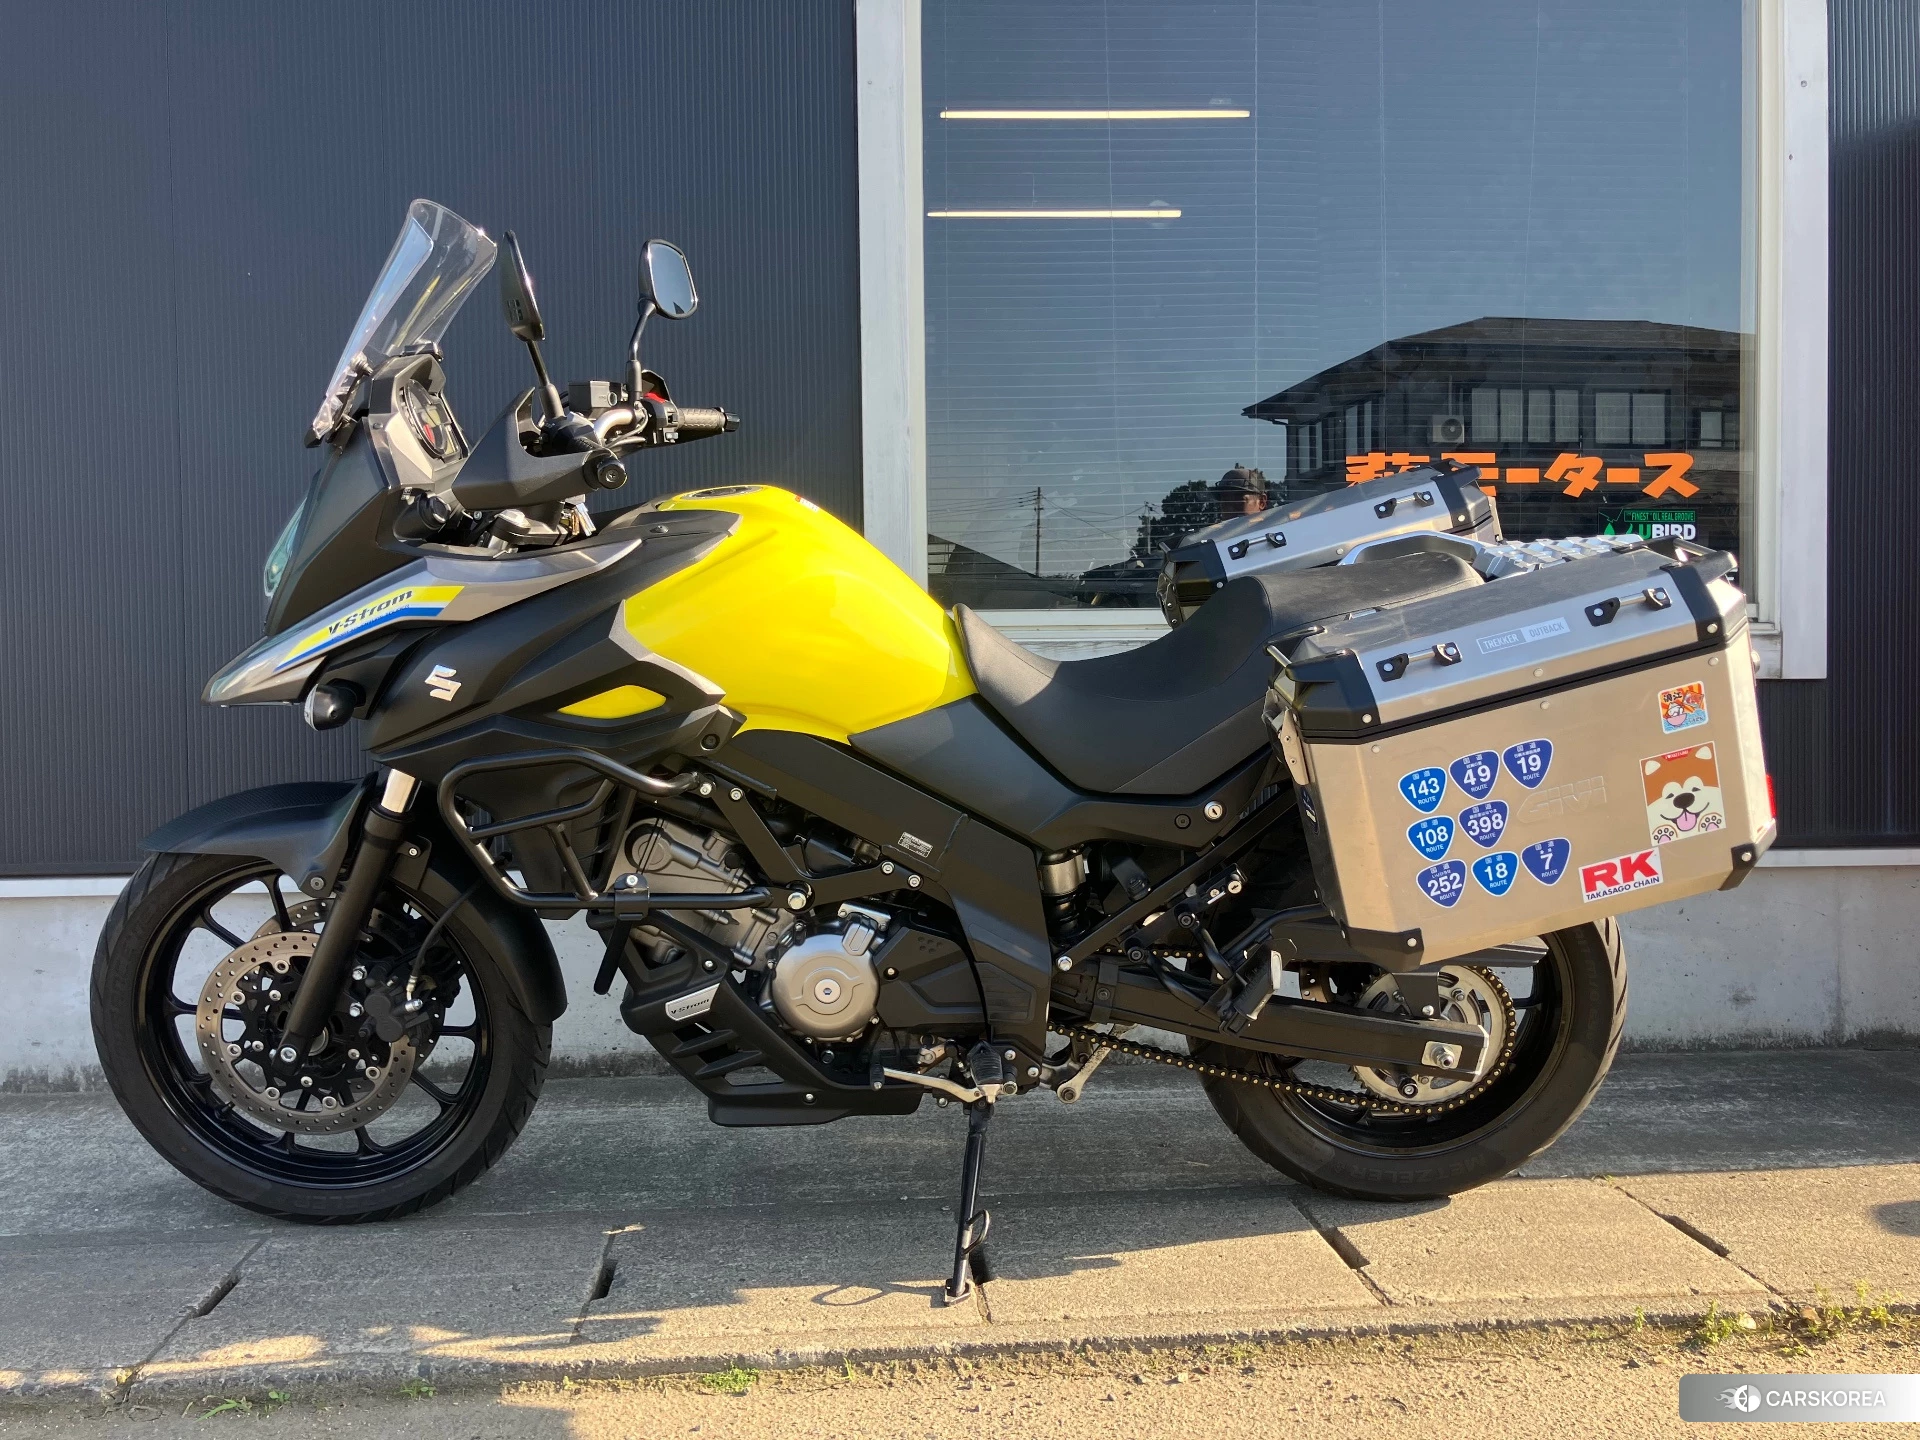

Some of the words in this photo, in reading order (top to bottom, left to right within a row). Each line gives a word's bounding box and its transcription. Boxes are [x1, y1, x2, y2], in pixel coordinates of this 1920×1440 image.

[1483, 633, 1520, 650] TREKKER
[1529, 621, 1565, 638] OUTBACK
[1517, 754, 1541, 774] 19
[1463, 765, 1491, 786] 49
[1523, 772, 1540, 780] ROUTE
[1408, 778, 1440, 799] 143
[1471, 783, 1488, 792] ROUTE
[1418, 796, 1436, 805] ROUTE
[1467, 813, 1503, 836] 398
[1416, 826, 1448, 847] 108
[1479, 832, 1496, 841] ROUTE
[1426, 844, 1444, 853] ROUTE
[1540, 853, 1553, 870] 7
[1484, 862, 1508, 881] 18
[1541, 869, 1559, 878] ROUTE
[1582, 850, 1659, 893] RK
[1427, 872, 1463, 897] 252
[1489, 879, 1507, 889] ROUTE
[1586, 884, 1631, 900] TAKASAGO
[1633, 876, 1660, 889] CHAIN
[1439, 891, 1456, 901] ROUTE
